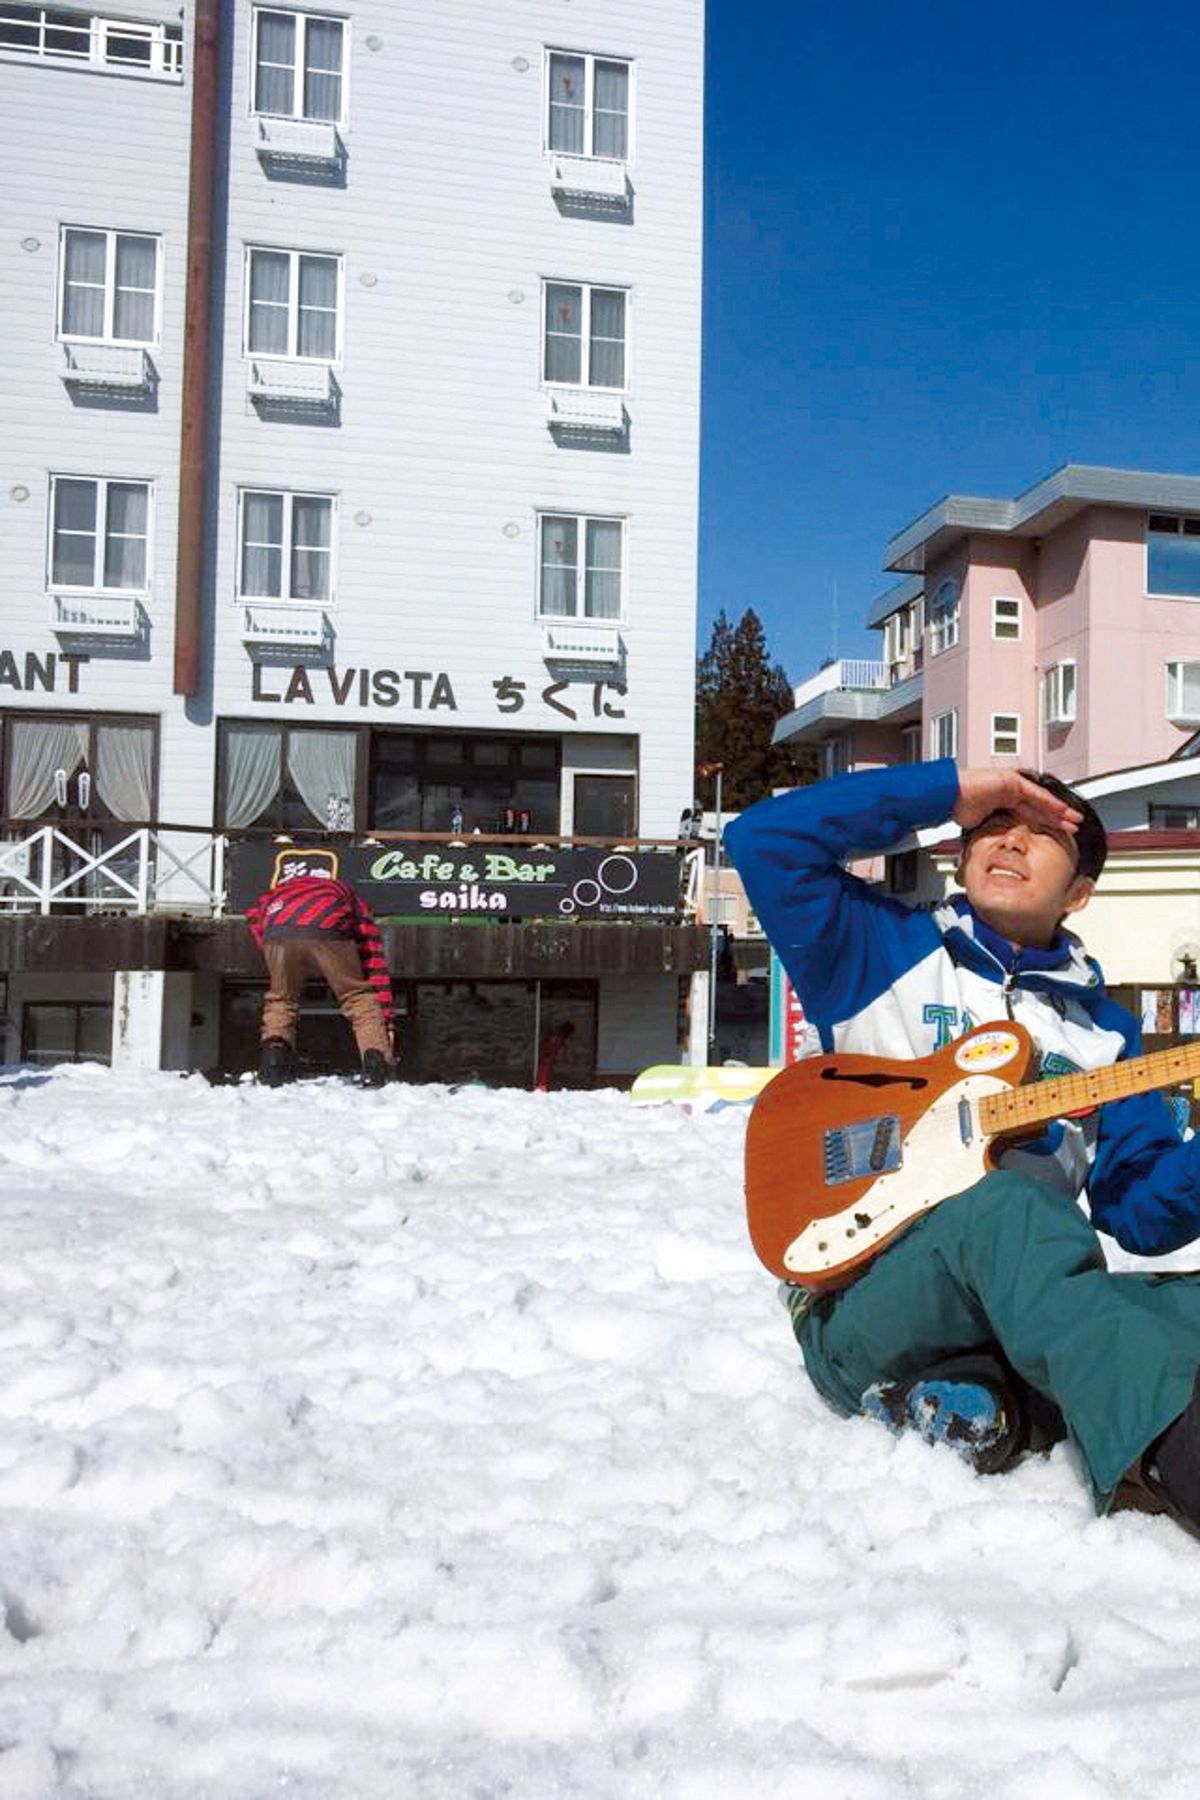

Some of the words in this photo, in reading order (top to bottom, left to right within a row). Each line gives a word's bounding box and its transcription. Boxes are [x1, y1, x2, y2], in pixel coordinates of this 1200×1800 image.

[0, 650, 90, 693] ANT
[251, 664, 315, 704] LA
[326, 667, 459, 711] VISTA
[493, 676, 629, 720] ちくに
[370, 850, 454, 882] Cafe
[458, 864, 480, 882] &
[485, 854, 556, 882] Bar
[419, 884, 508, 911] saika
